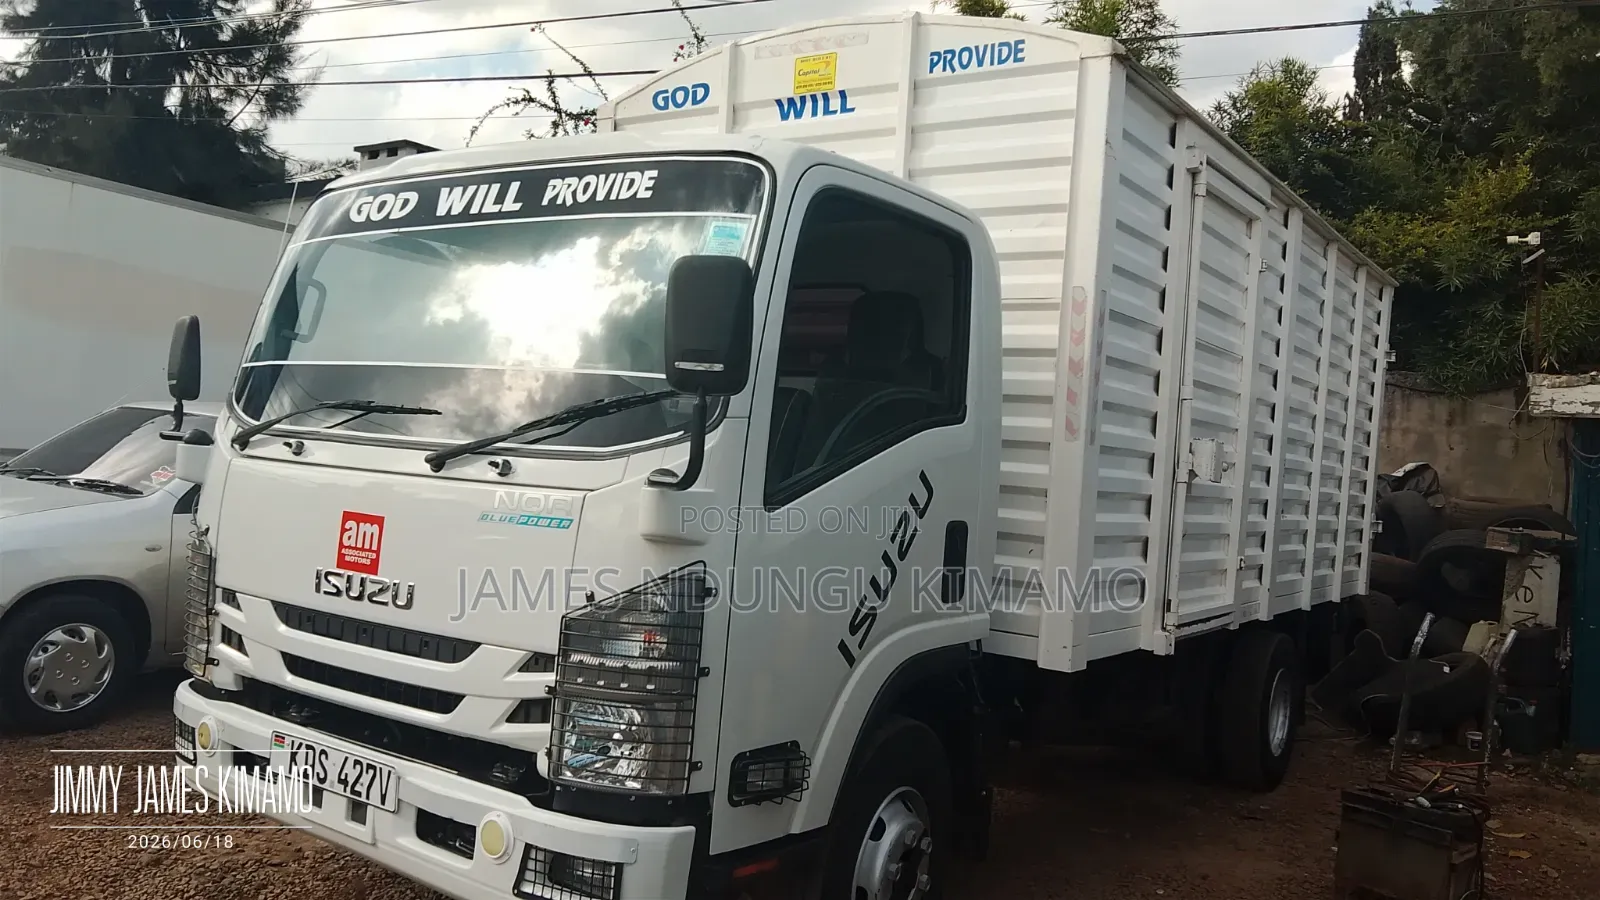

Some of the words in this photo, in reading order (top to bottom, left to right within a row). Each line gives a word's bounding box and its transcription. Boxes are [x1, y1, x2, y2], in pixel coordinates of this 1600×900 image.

[929, 39, 1026, 74] PROVIDE
[652, 82, 710, 111] GOD
[775, 90, 856, 121] WILL
[349, 191, 419, 223] GOD
[435, 181, 523, 217] WILL
[541, 170, 658, 207] PROVIDE
[342, 520, 380, 551] am
[341, 547, 377, 559] ASSOCIATED
[344, 555, 371, 565] MOTORS
[837, 469, 934, 669] ISUZU
[314, 566, 416, 611] ISUZU
[337, 755, 392, 806] 427V
